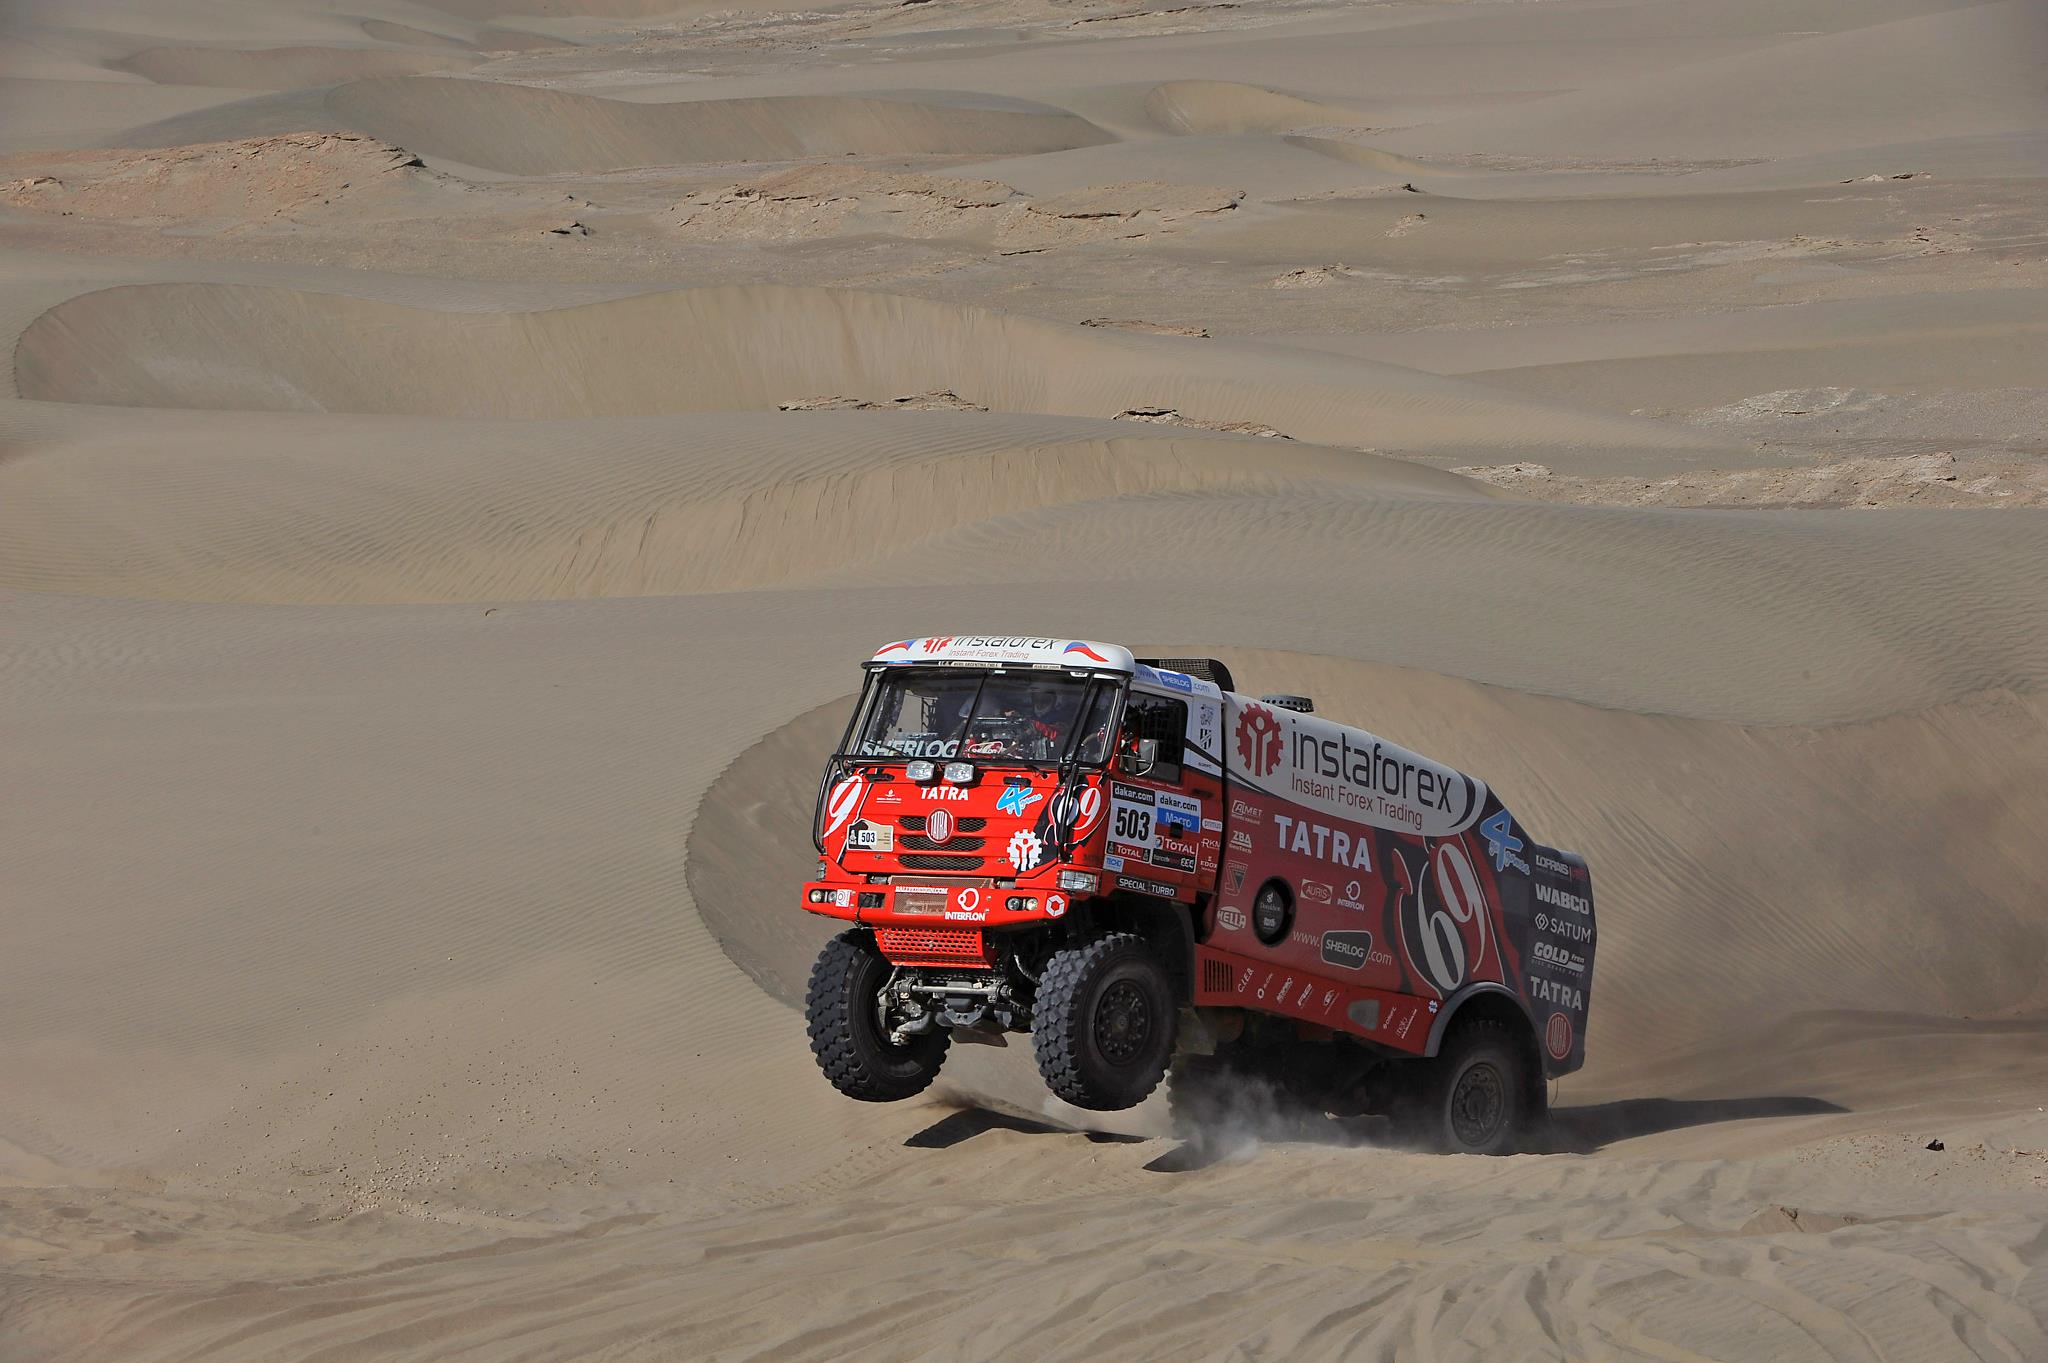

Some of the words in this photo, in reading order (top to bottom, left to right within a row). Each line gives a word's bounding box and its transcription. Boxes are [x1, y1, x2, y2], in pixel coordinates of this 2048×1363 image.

[949, 648, 973, 657] Instant
[975, 650, 999, 658] Forex
[1001, 651, 1030, 660] Trading
[1292, 718, 1452, 813] instaforex
[921, 787, 969, 800] TATRA
[1114, 785, 1154, 803] dakar.com
[1291, 772, 1335, 801] Instant
[1338, 785, 1374, 812] Forex
[1377, 796, 1422, 831] Trading
[1160, 795, 1198, 812] dakar.com
[1115, 806, 1151, 842] 503
[1165, 812, 1192, 828] Macro
[861, 832, 876, 843] 503
[1165, 838, 1196, 855] TOTAL
[1274, 814, 1372, 872] TATRA
[1116, 845, 1141, 858] TOTAL
[1535, 855, 1569, 876] LOPRAIS
[1119, 878, 1146, 891] SPECIAL
[1152, 884, 1175, 897] TURBO
[1305, 885, 1328, 899] AURIS
[1337, 898, 1365, 911] INTERFLON
[1535, 883, 1590, 915] WABCO
[945, 911, 986, 922] INTERFLON
[1217, 910, 1247, 928] HELLA
[1417, 843, 1486, 990] 69
[1550, 918, 1592, 943] SATUM
[1533, 942, 1570, 964] GOLD
[1530, 976, 1583, 1011] TATRA
